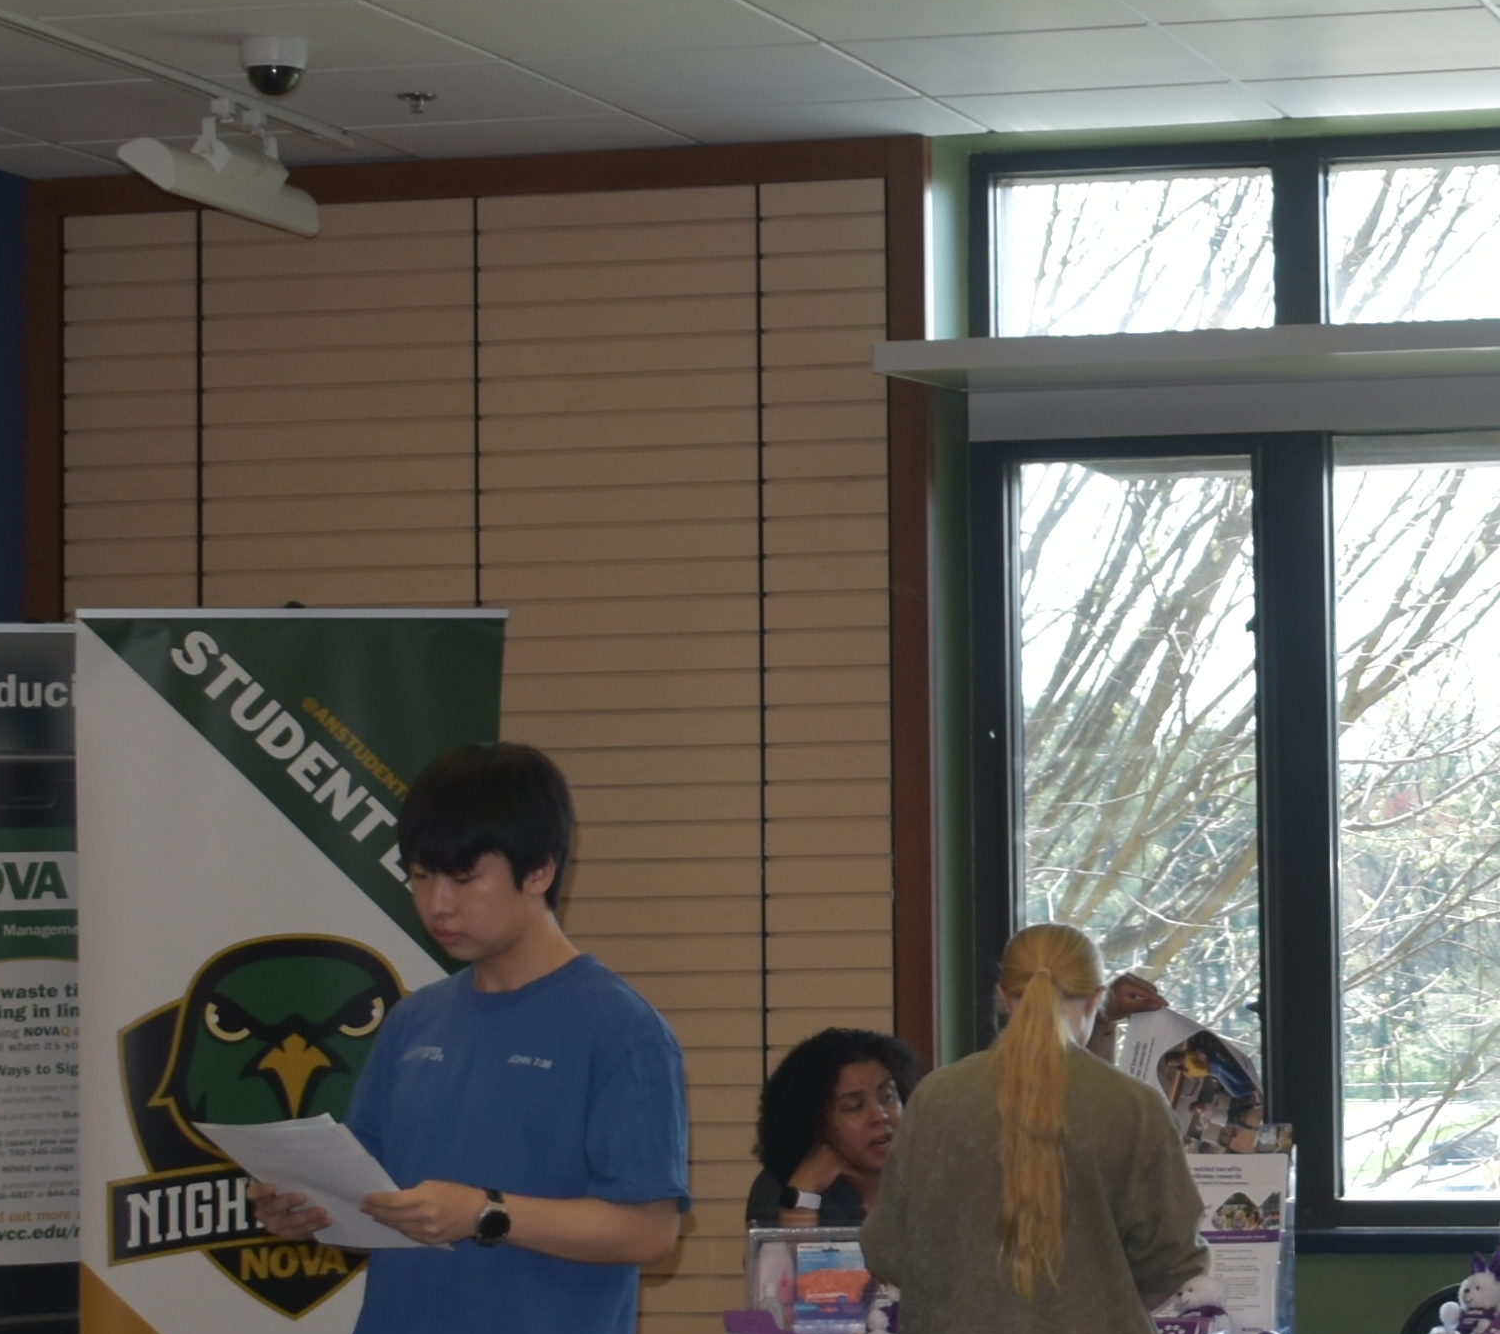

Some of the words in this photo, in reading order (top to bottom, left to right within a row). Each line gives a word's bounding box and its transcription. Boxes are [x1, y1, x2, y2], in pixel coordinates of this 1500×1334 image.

[170, 630, 398, 843] STUDENT
[0, 984, 58, 999] waste
[33, 1005, 47, 1019] in
[24, 1026, 71, 1038] NOVAQ
[8, 1042, 41, 1052] when
[44, 1041, 61, 1051] it's
[507, 1055, 531, 1065] JOHN
[36, 1064, 51, 1076] to
[9, 1211, 32, 1223] out
[37, 1210, 71, 1222] more
[240, 1243, 349, 1281] NOVA
